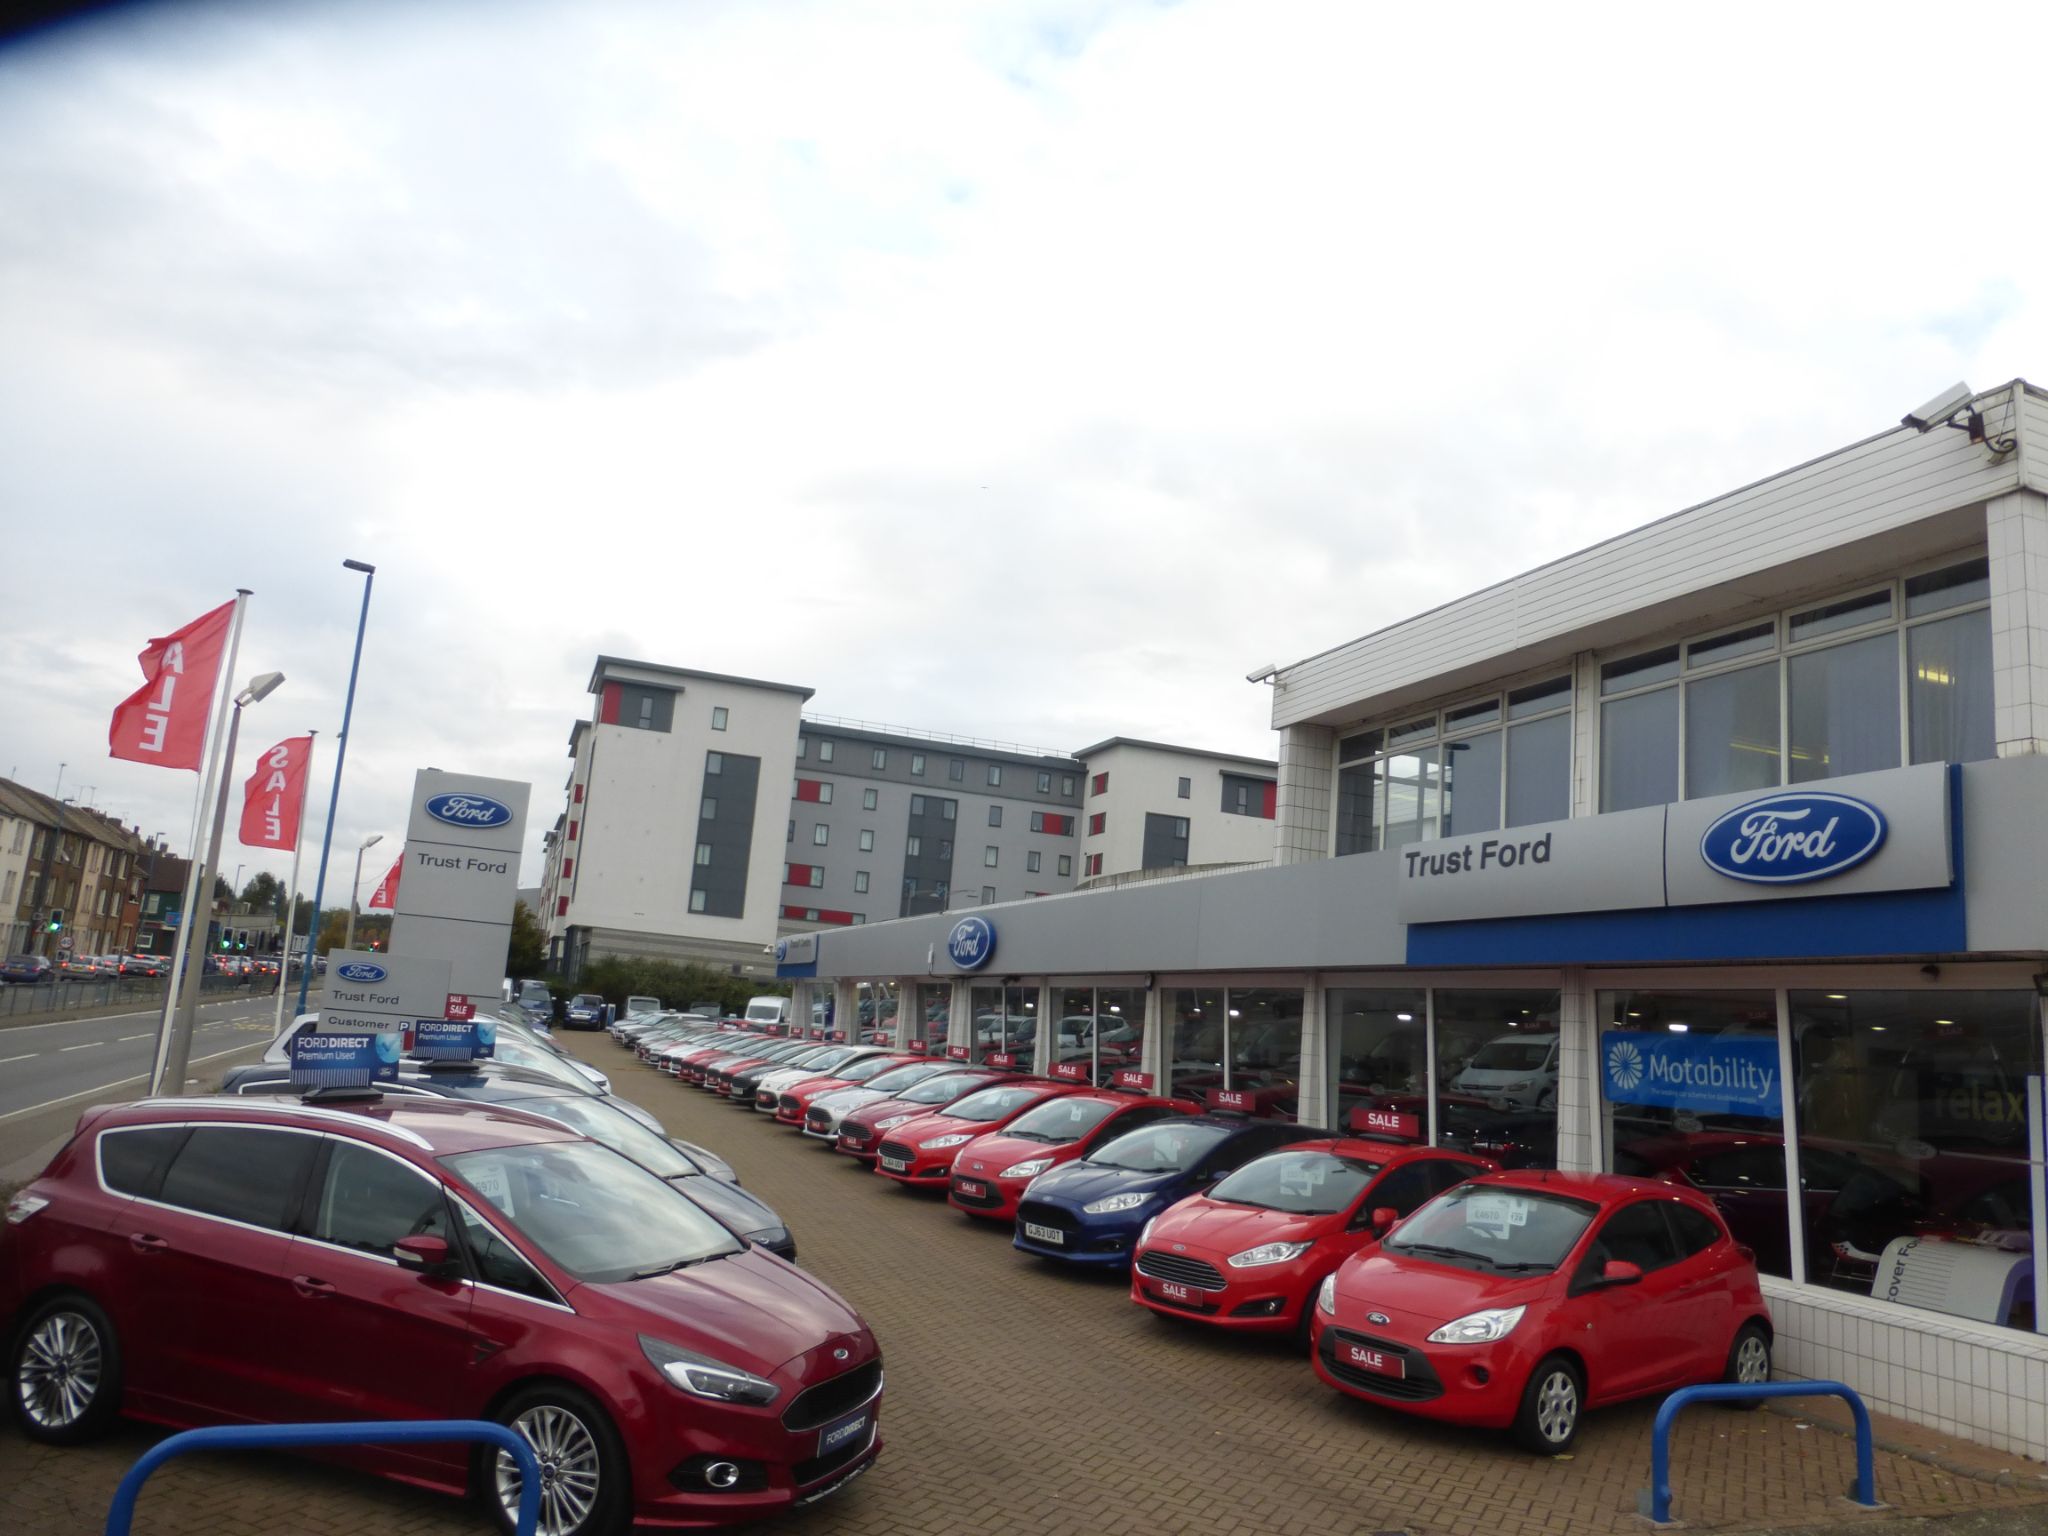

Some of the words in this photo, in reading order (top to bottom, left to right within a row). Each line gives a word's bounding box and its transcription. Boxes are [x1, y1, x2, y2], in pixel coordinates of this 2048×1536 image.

[441, 797, 497, 822] Ford
[1730, 807, 1840, 864] Ford
[418, 852, 463, 870] Trust
[467, 858, 508, 875] Ford
[1405, 844, 1473, 879] Trust
[1479, 832, 1552, 870] Ford
[953, 924, 981, 958] Ford
[346, 963, 378, 980] Ford
[333, 990, 366, 1003] Trust
[369, 993, 400, 1005] Ford
[449, 1004, 468, 1015] SALE
[328, 1016, 390, 1030] Customer
[912, 1040, 923, 1049] SALE
[952, 1046, 965, 1056] SALE
[297, 1050, 334, 1061] Premium
[335, 1050, 356, 1061] Used
[993, 1053, 1009, 1063] SALE
[1057, 1064, 1077, 1076] SALE
[1650, 1053, 1774, 1099] Motability
[1123, 1072, 1143, 1085] SALE
[1218, 1091, 1242, 1105] SALE
[1936, 1078, 2025, 1122] relax
[1367, 1112, 1400, 1129] SALE
[961, 1182, 977, 1193] SALE
[1162, 1282, 1187, 1299] SALE
[1350, 1347, 1383, 1367] SALE
